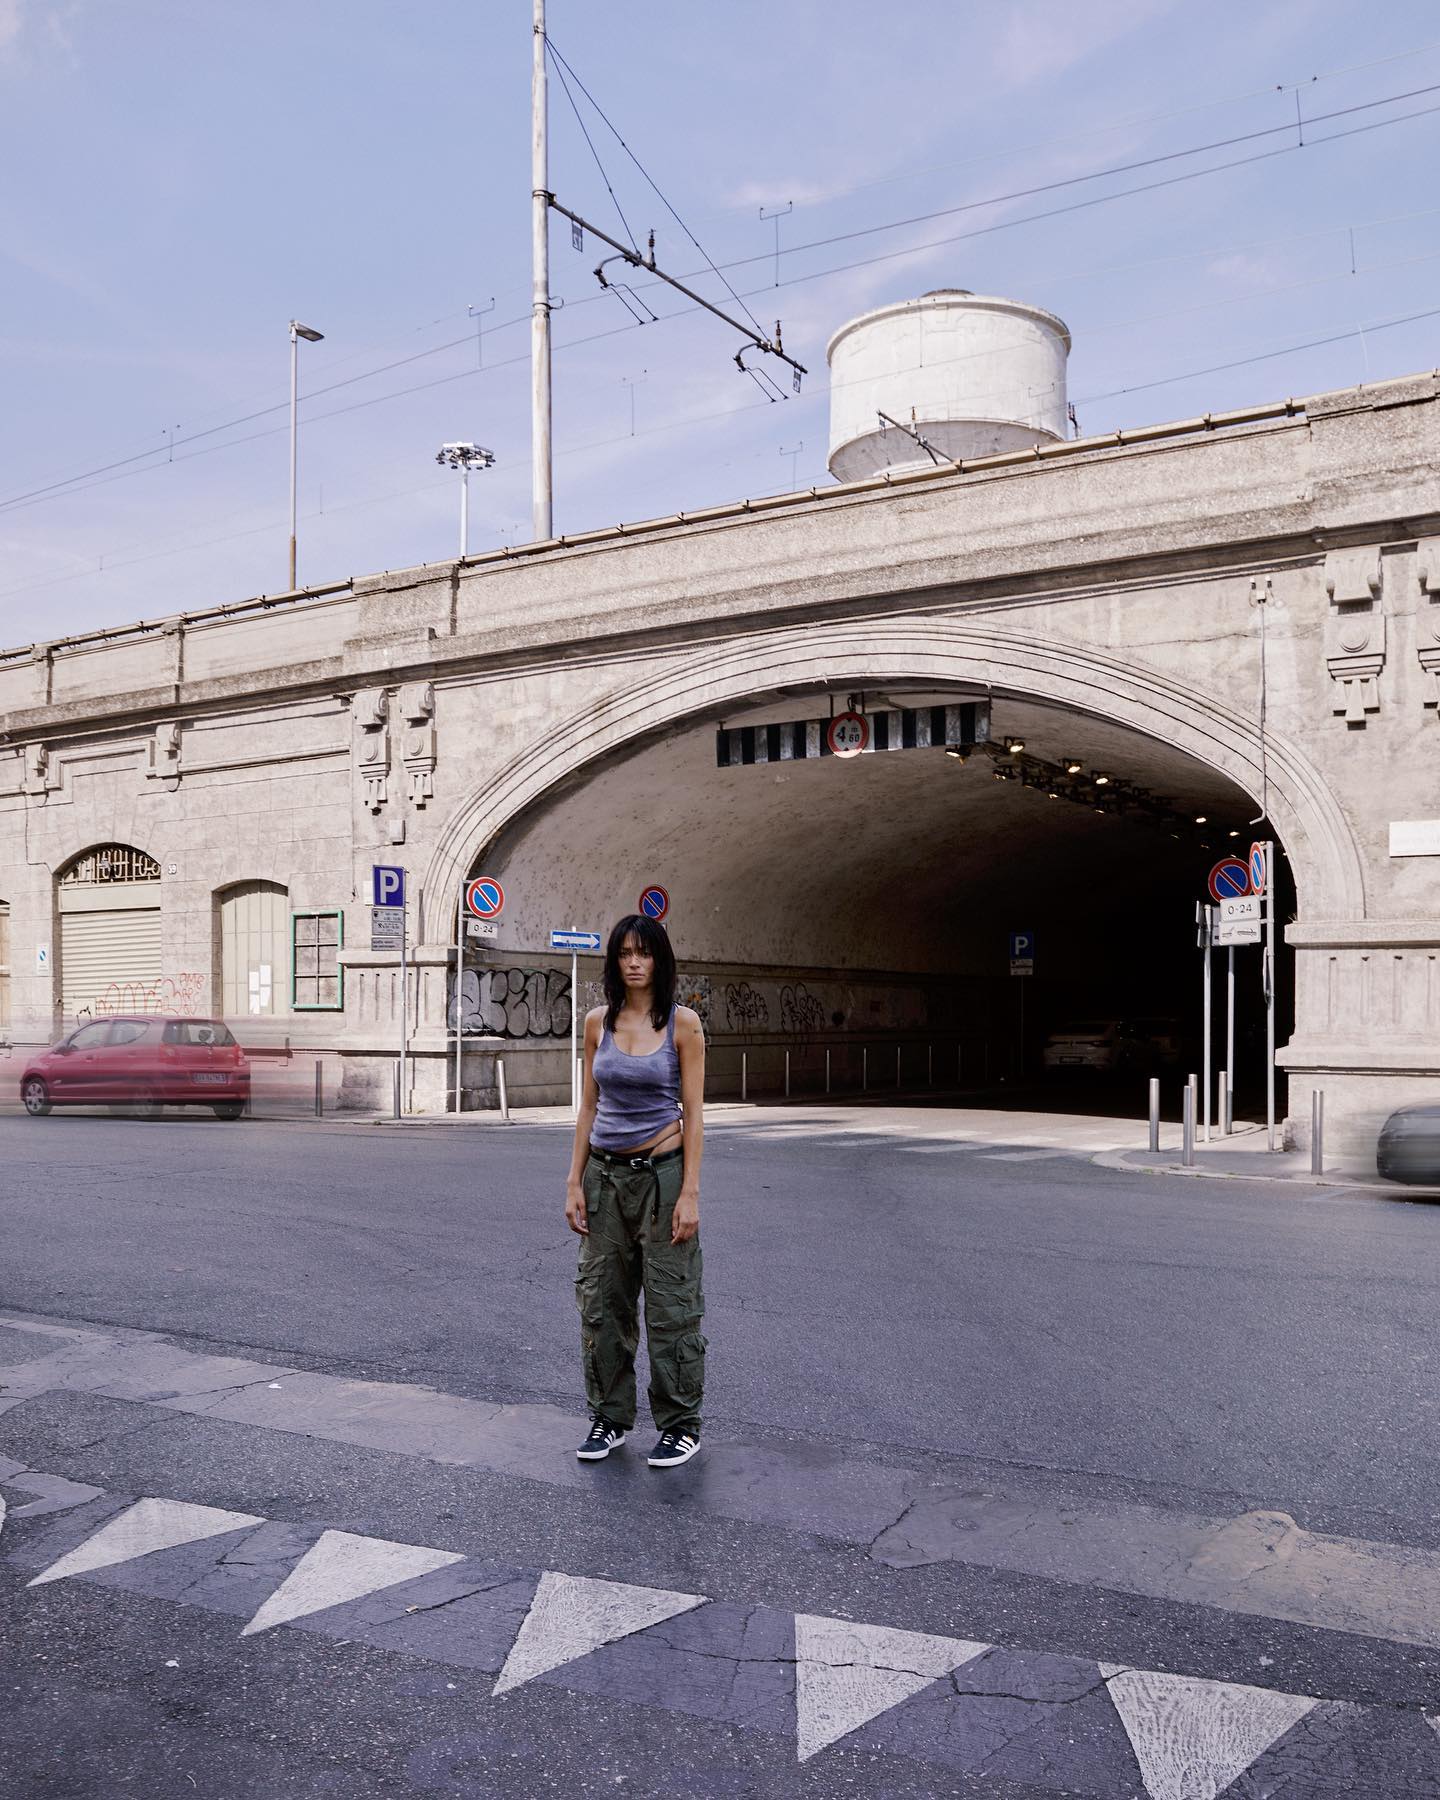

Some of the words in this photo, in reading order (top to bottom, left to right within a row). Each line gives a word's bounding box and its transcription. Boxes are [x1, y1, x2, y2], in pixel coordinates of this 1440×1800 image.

[380, 869, 400, 904] P
[1228, 904, 1252, 915] 0-24
[474, 924, 493, 933] 0-24
[1015, 936, 1028, 955] P
